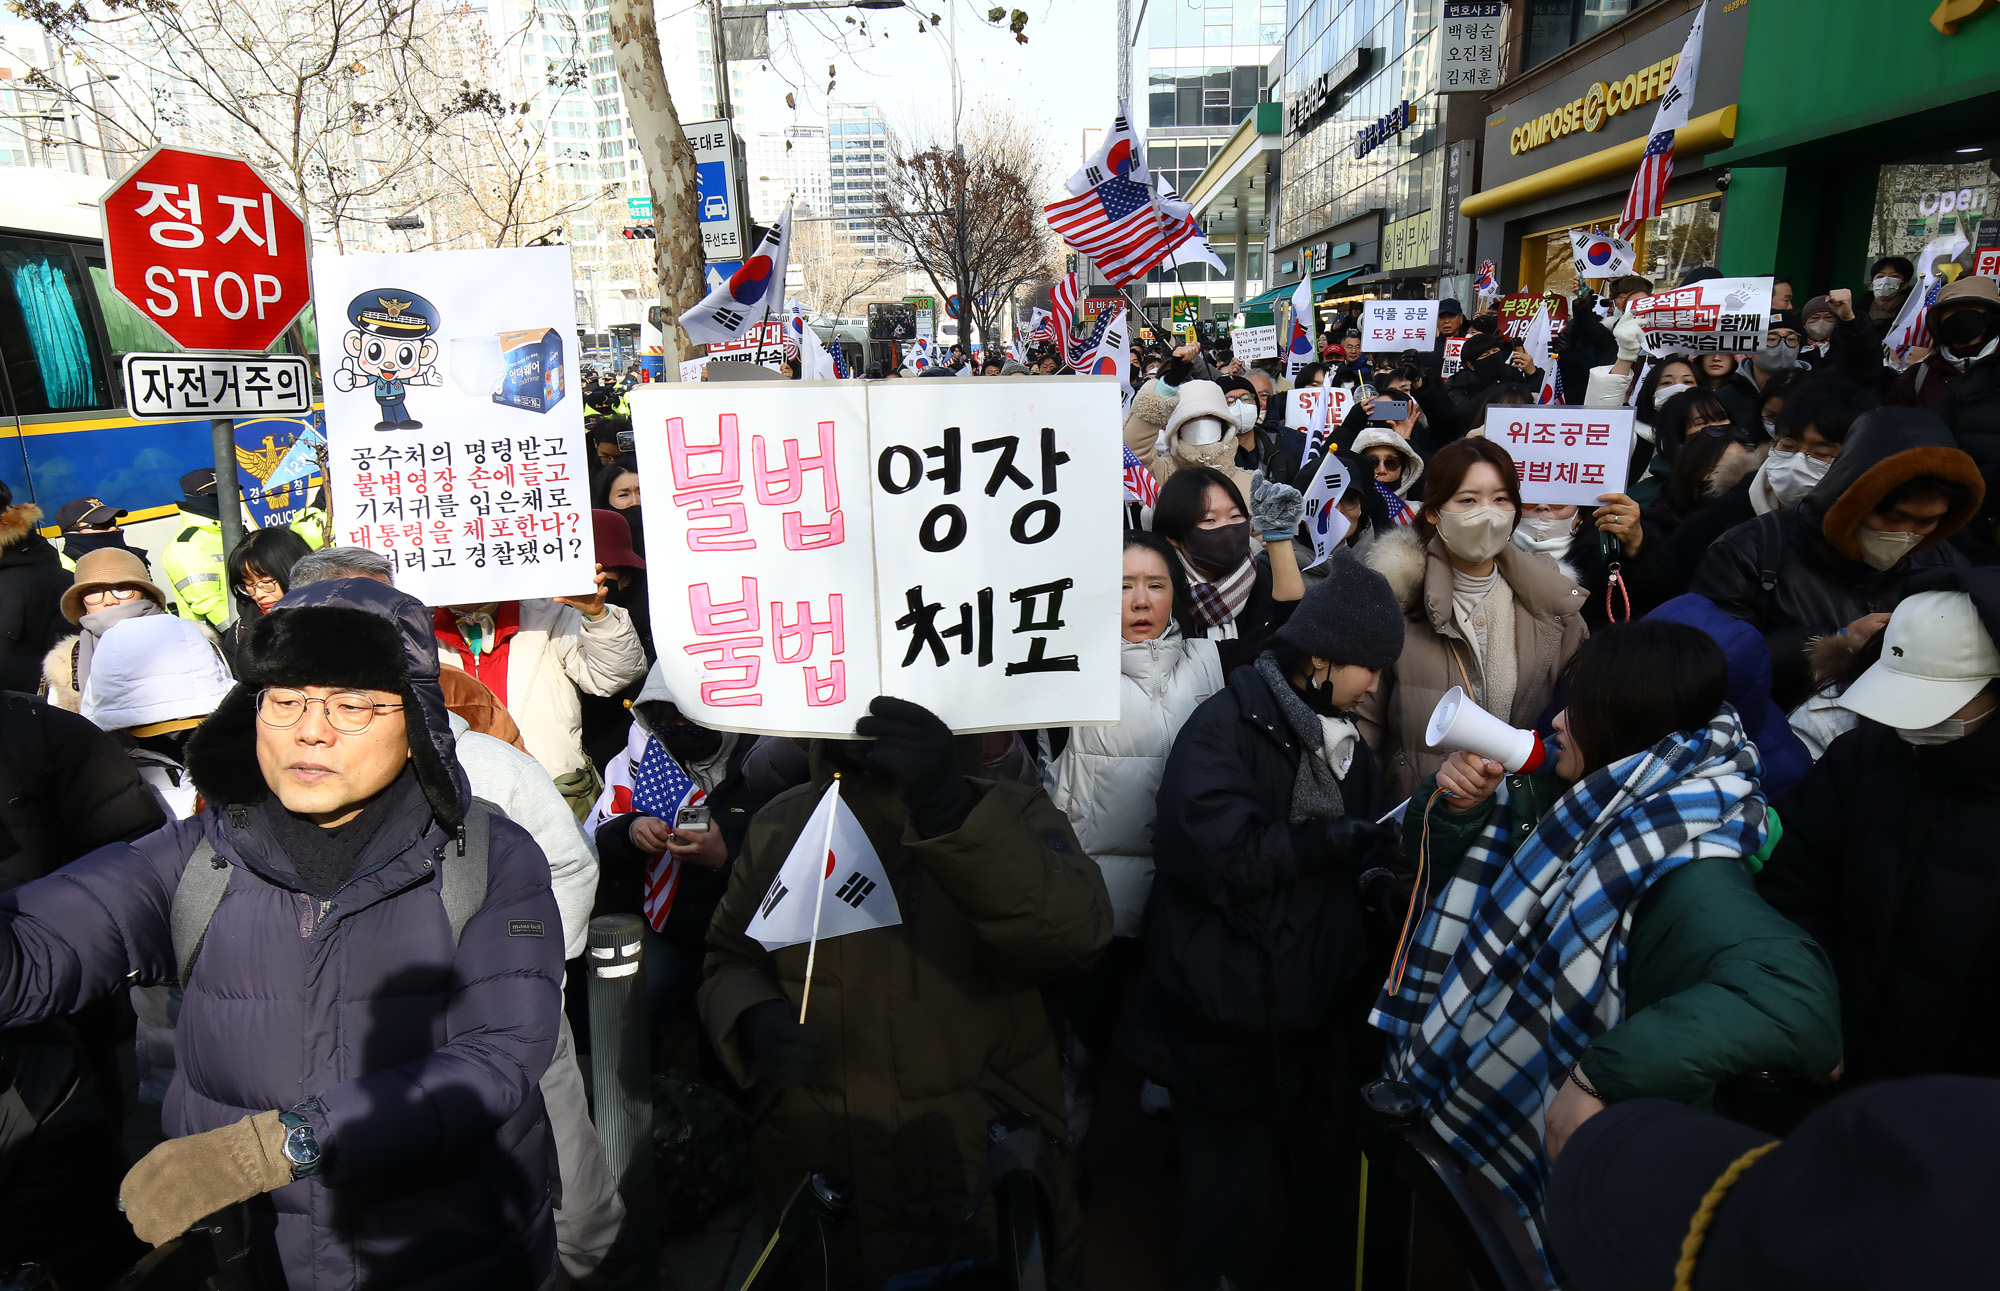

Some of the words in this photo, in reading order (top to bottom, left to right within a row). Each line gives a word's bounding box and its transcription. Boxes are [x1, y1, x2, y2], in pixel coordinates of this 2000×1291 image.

[1450, 5, 1481, 16] 변호사
[1485, 5, 1497, 15] 3F
[1448, 23, 1495, 40] 백형순
[1446, 44, 1492, 62] 오진철
[1446, 68, 1492, 85] 김재훈
[1510, 97, 1584, 156] COMPOSE
[687, 133, 726, 151] 포대로
[134, 181, 279, 257] 정지
[700, 232, 737, 249] 우선도로
[1396, 220, 1430, 263] 법무사
[144, 265, 283, 320] STOP
[916, 298, 929, 310] 03
[1636, 289, 1697, 312] 윤석열
[1373, 307, 1397, 321] 딱풀
[1403, 307, 1429, 321] 공문
[1501, 297, 1561, 317] 부정선거
[1371, 328, 1397, 341] 도장
[1402, 328, 1427, 341] 도둑
[1503, 319, 1567, 338] 개입단
[1720, 313, 1762, 332] 함께
[1645, 331, 1760, 352] 싸우겠습니다
[509, 360, 540, 385] 언더웨어
[141, 364, 304, 409] 자전거주의
[1506, 421, 1611, 446] 위조공문
[350, 441, 453, 471] 공수처의
[464, 436, 568, 465] 명령받고
[353, 467, 457, 497] 불법영장
[467, 462, 570, 490] 손에들고
[665, 412, 846, 552] 불법
[877, 426, 1071, 553] 영장
[355, 494, 459, 523] 기저귀를
[470, 487, 572, 516] 입은채로
[349, 520, 453, 549] 대통령을
[462, 511, 580, 543] 체포한다?
[382, 547, 456, 575] 러려고
[464, 537, 582, 568] 경찰됐어?
[683, 576, 846, 707] 불법
[895, 577, 1080, 677] 체포
